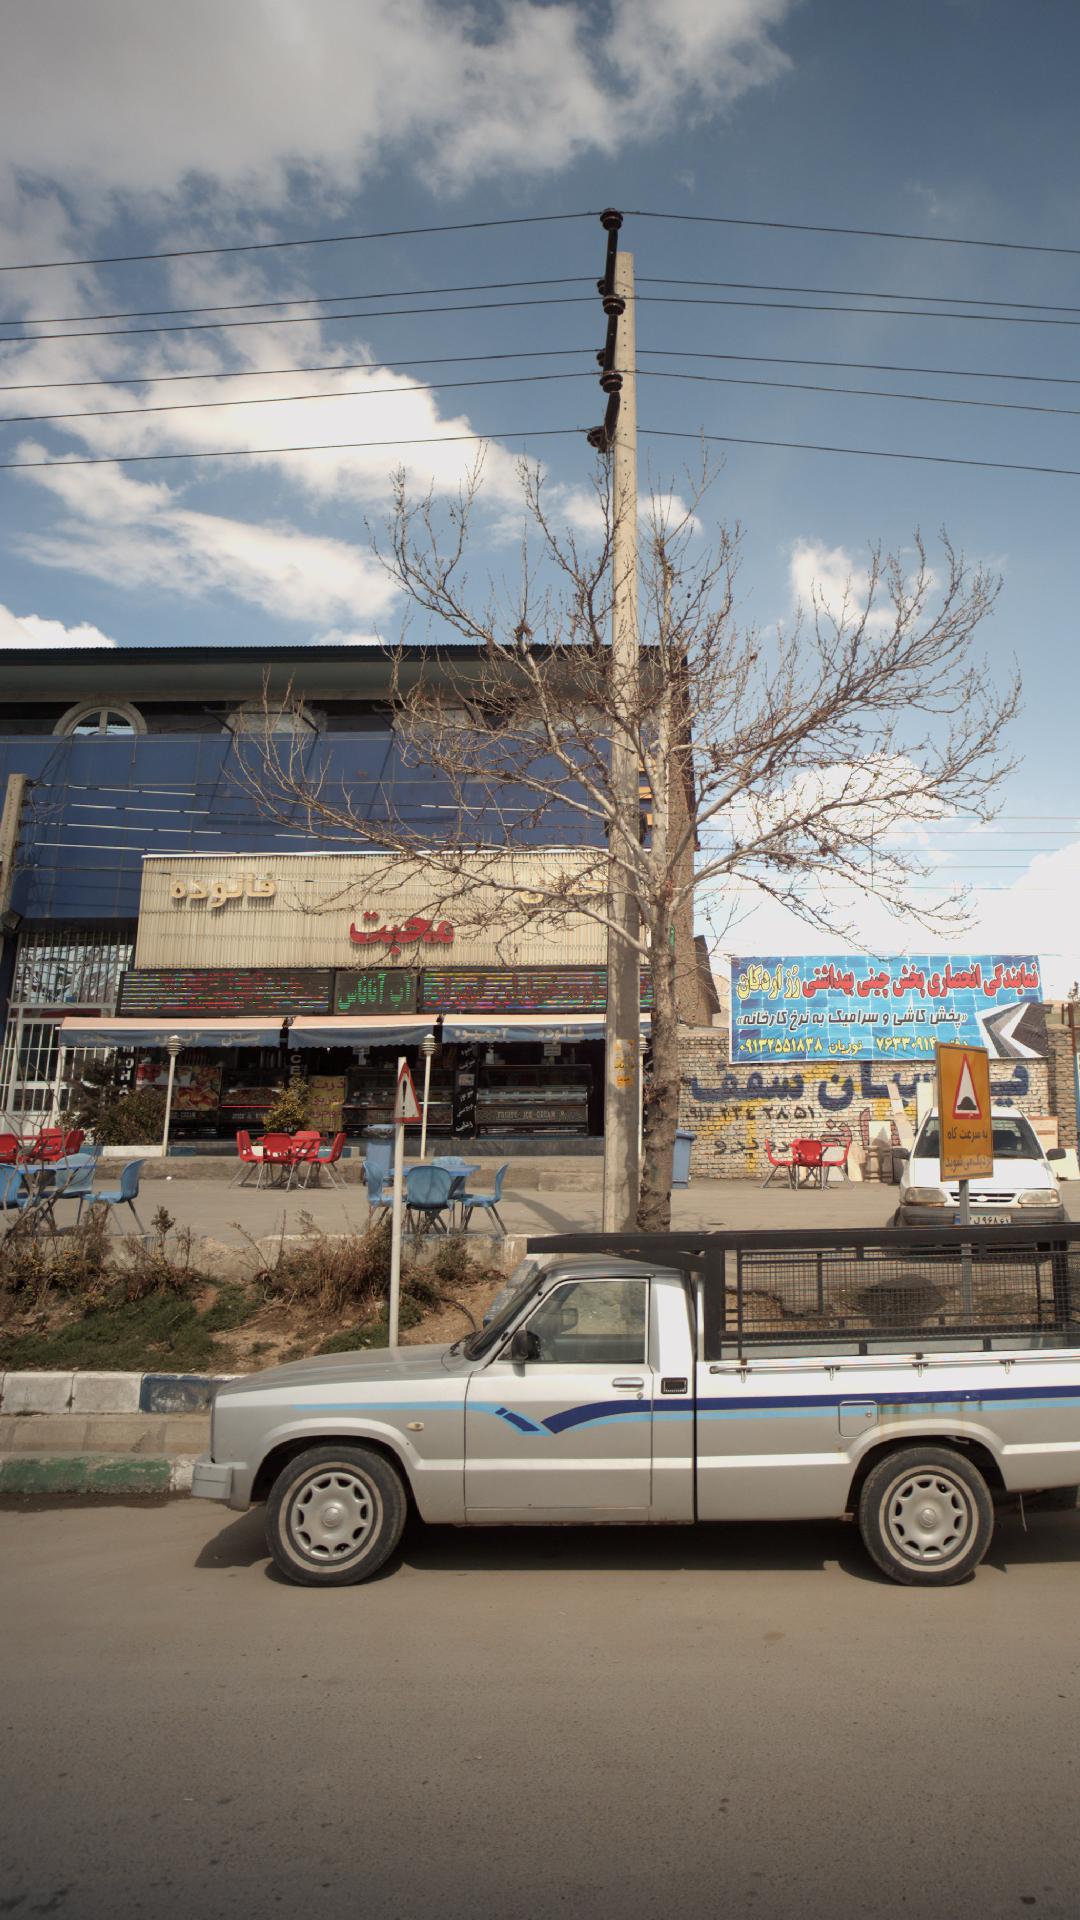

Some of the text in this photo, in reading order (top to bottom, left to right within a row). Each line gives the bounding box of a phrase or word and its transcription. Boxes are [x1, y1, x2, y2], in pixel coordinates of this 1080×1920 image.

[170, 872, 277, 908] فالوده
[350, 911, 455, 955] محبت
[737, 964, 783, 999] اردکان
[802, 963, 854, 998] بهداشتی
[857, 968, 890, 998] چینی
[893, 965, 925, 998] پخش
[928, 964, 980, 997] انحصاری
[984, 963, 1038, 996] نمایندگی
[789, 1011, 810, 1031] نرخ
[812, 1013, 824, 1027] به
[829, 1010, 878, 1026] سرامیک
[882, 1014, 889, 1025] و
[893, 1008, 925, 1026] کاشی
[829, 1040, 862, 1055] نوریان
[960, 1129, 981, 1142] سرعت
